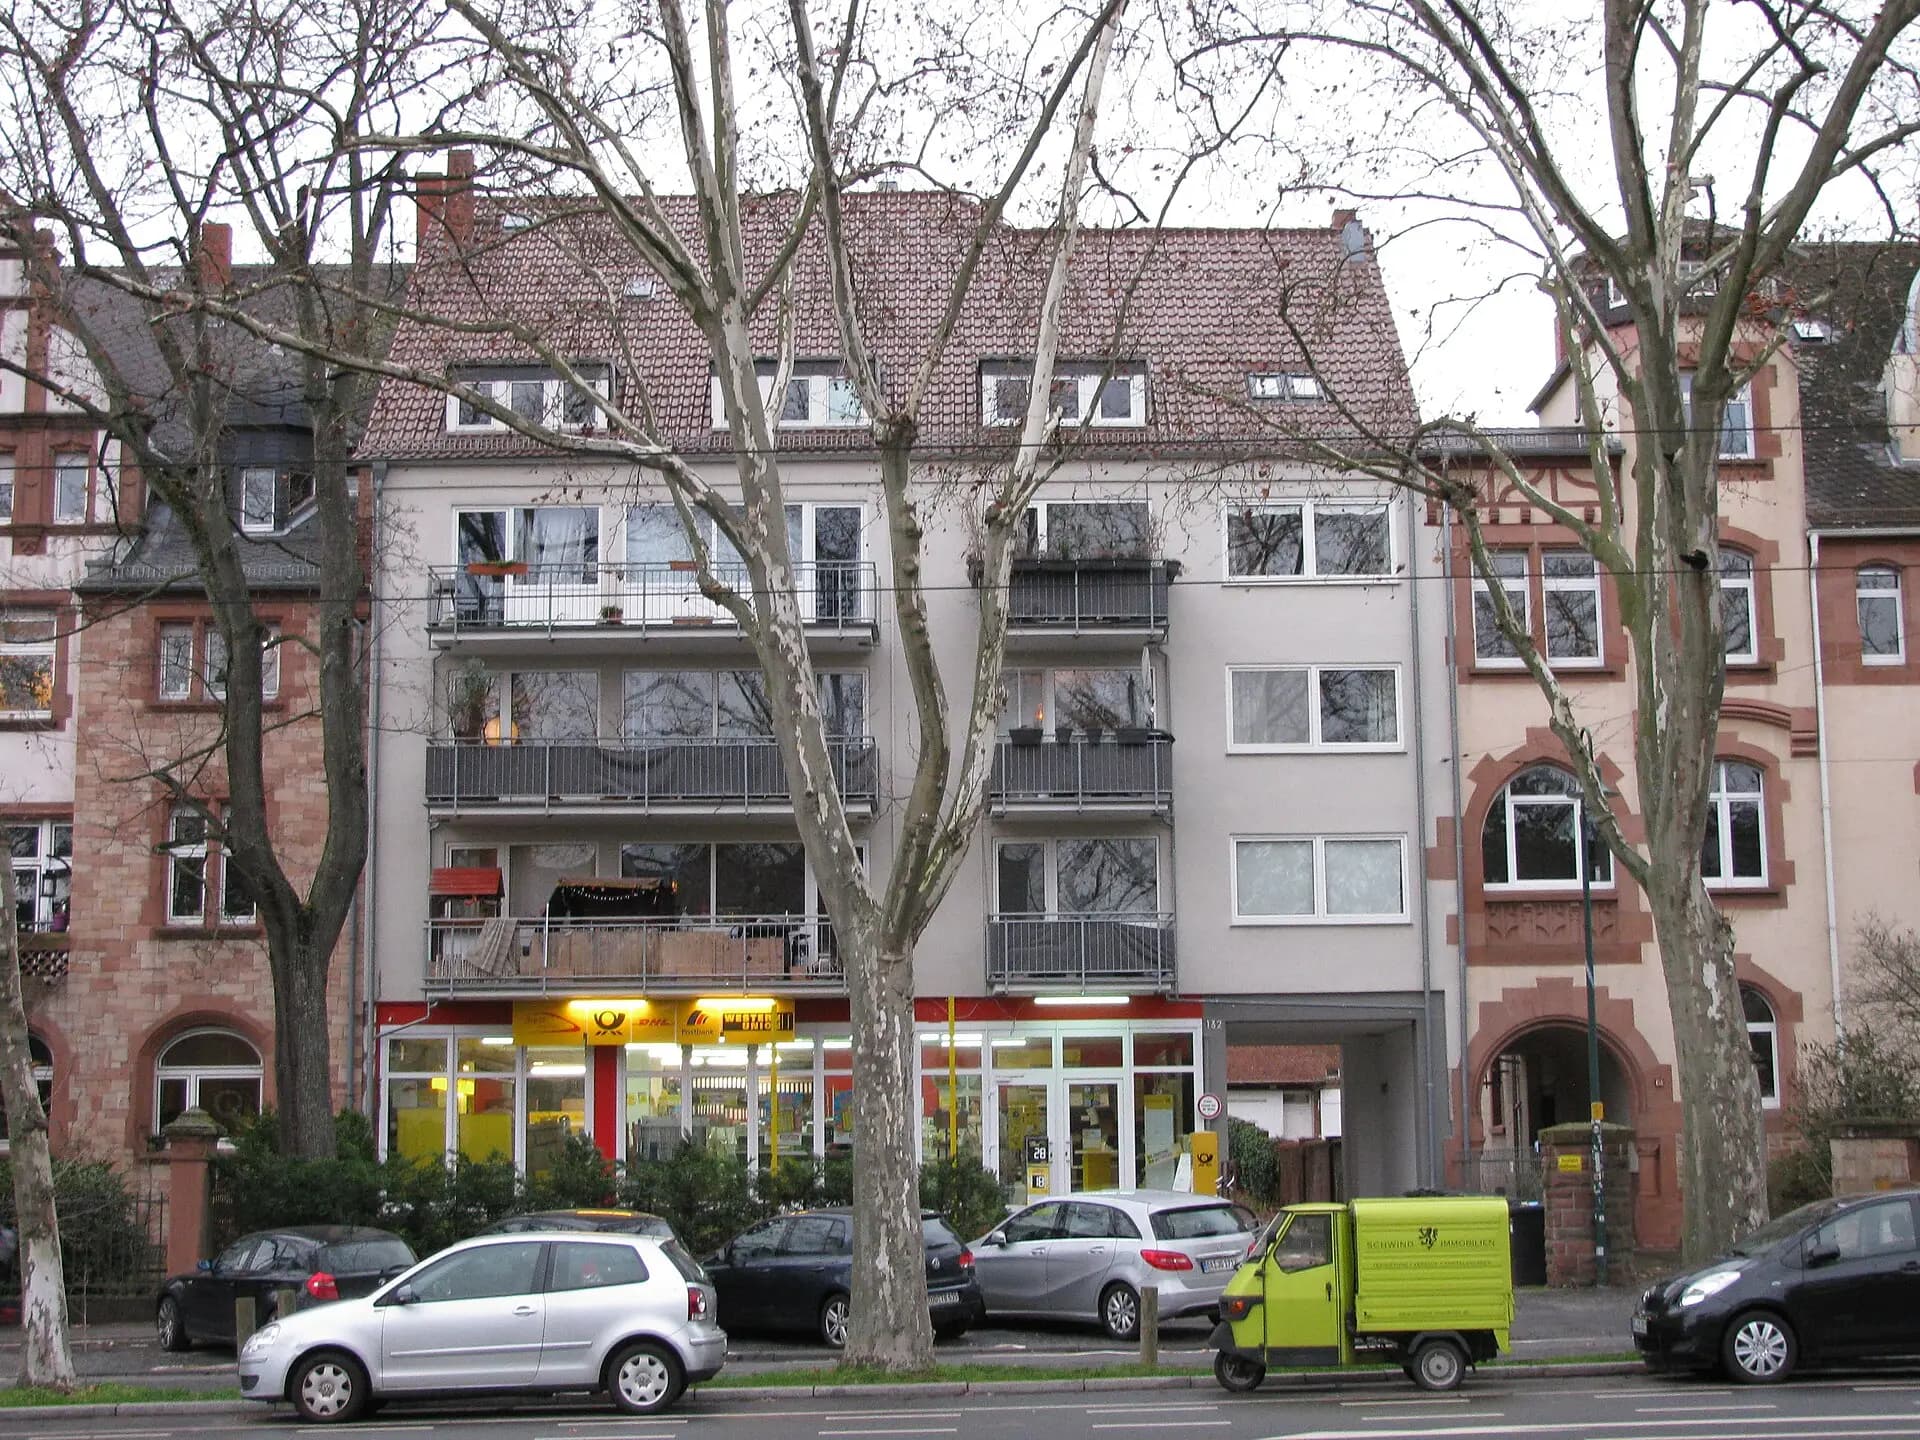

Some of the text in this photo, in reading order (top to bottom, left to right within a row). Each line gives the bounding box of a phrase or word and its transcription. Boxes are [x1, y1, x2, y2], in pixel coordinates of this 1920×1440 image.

[724, 1013, 778, 1022] WESTER
[742, 1022, 778, 1031] UNIO
[1033, 1147, 1046, 1160] 28
